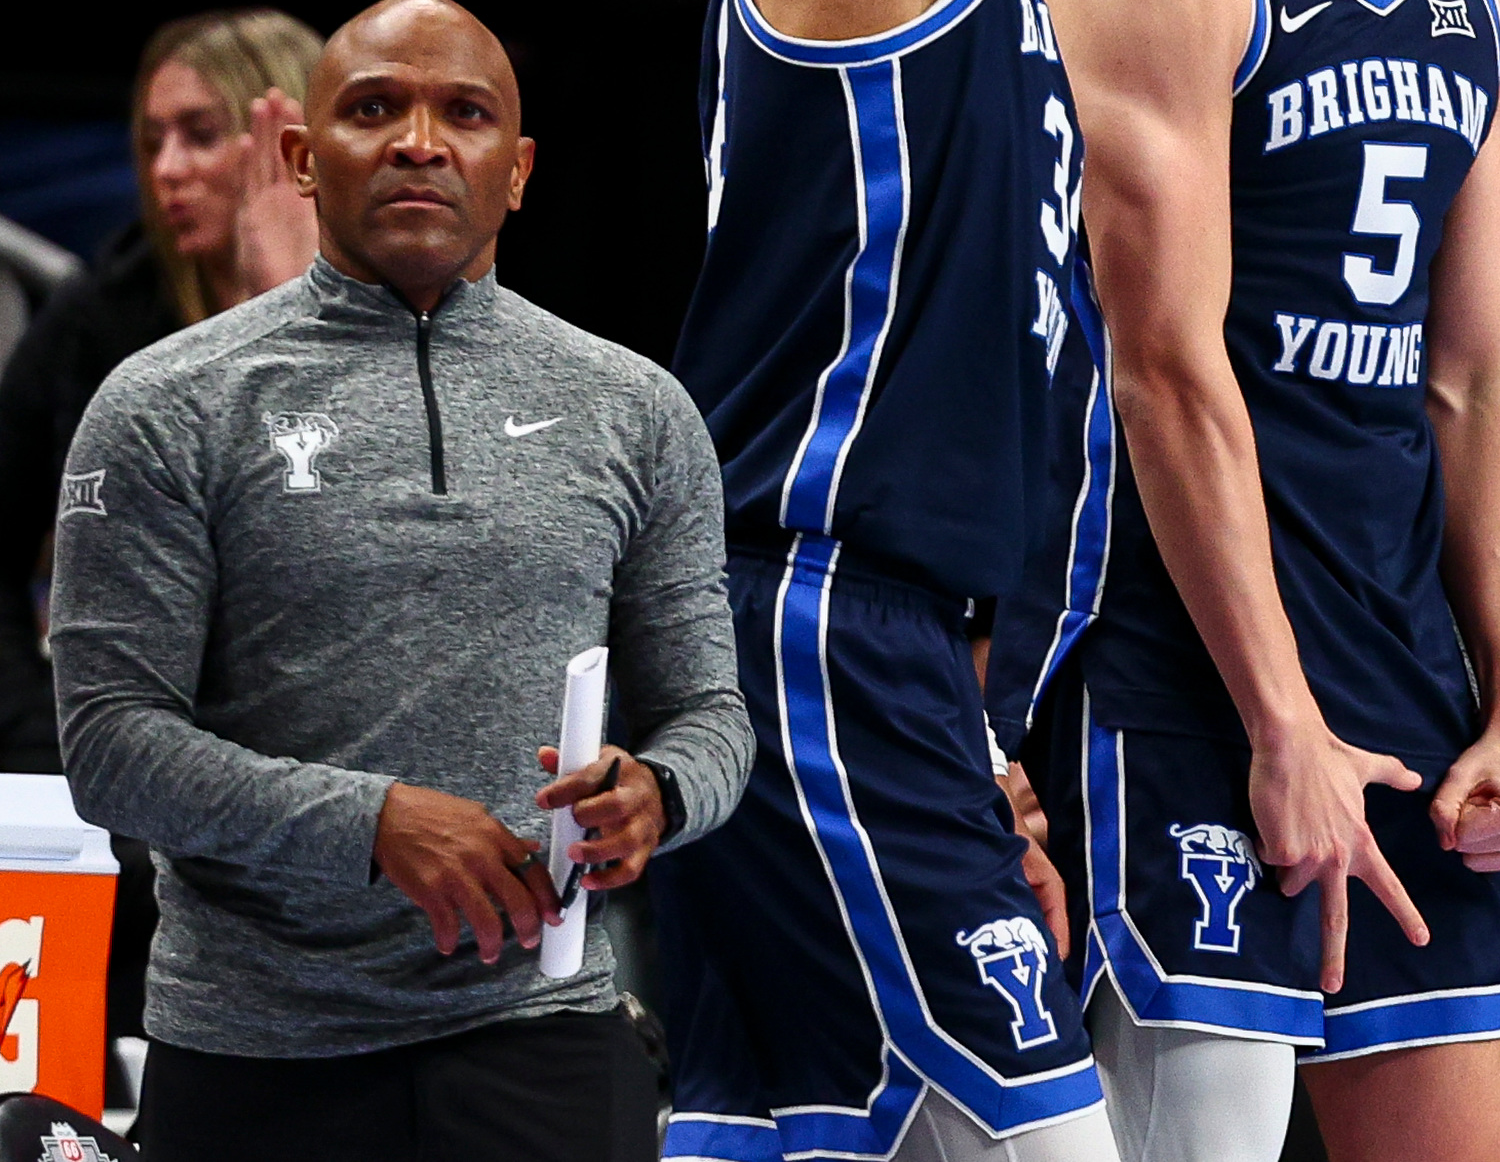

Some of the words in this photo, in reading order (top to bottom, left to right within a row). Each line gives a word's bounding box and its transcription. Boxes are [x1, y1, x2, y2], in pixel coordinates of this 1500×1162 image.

[1264, 57, 1489, 156] BRIGHAM
[1040, 92, 1083, 268] 3
[1342, 142, 1430, 306] 5
[1273, 313, 1424, 387] YOUNG
